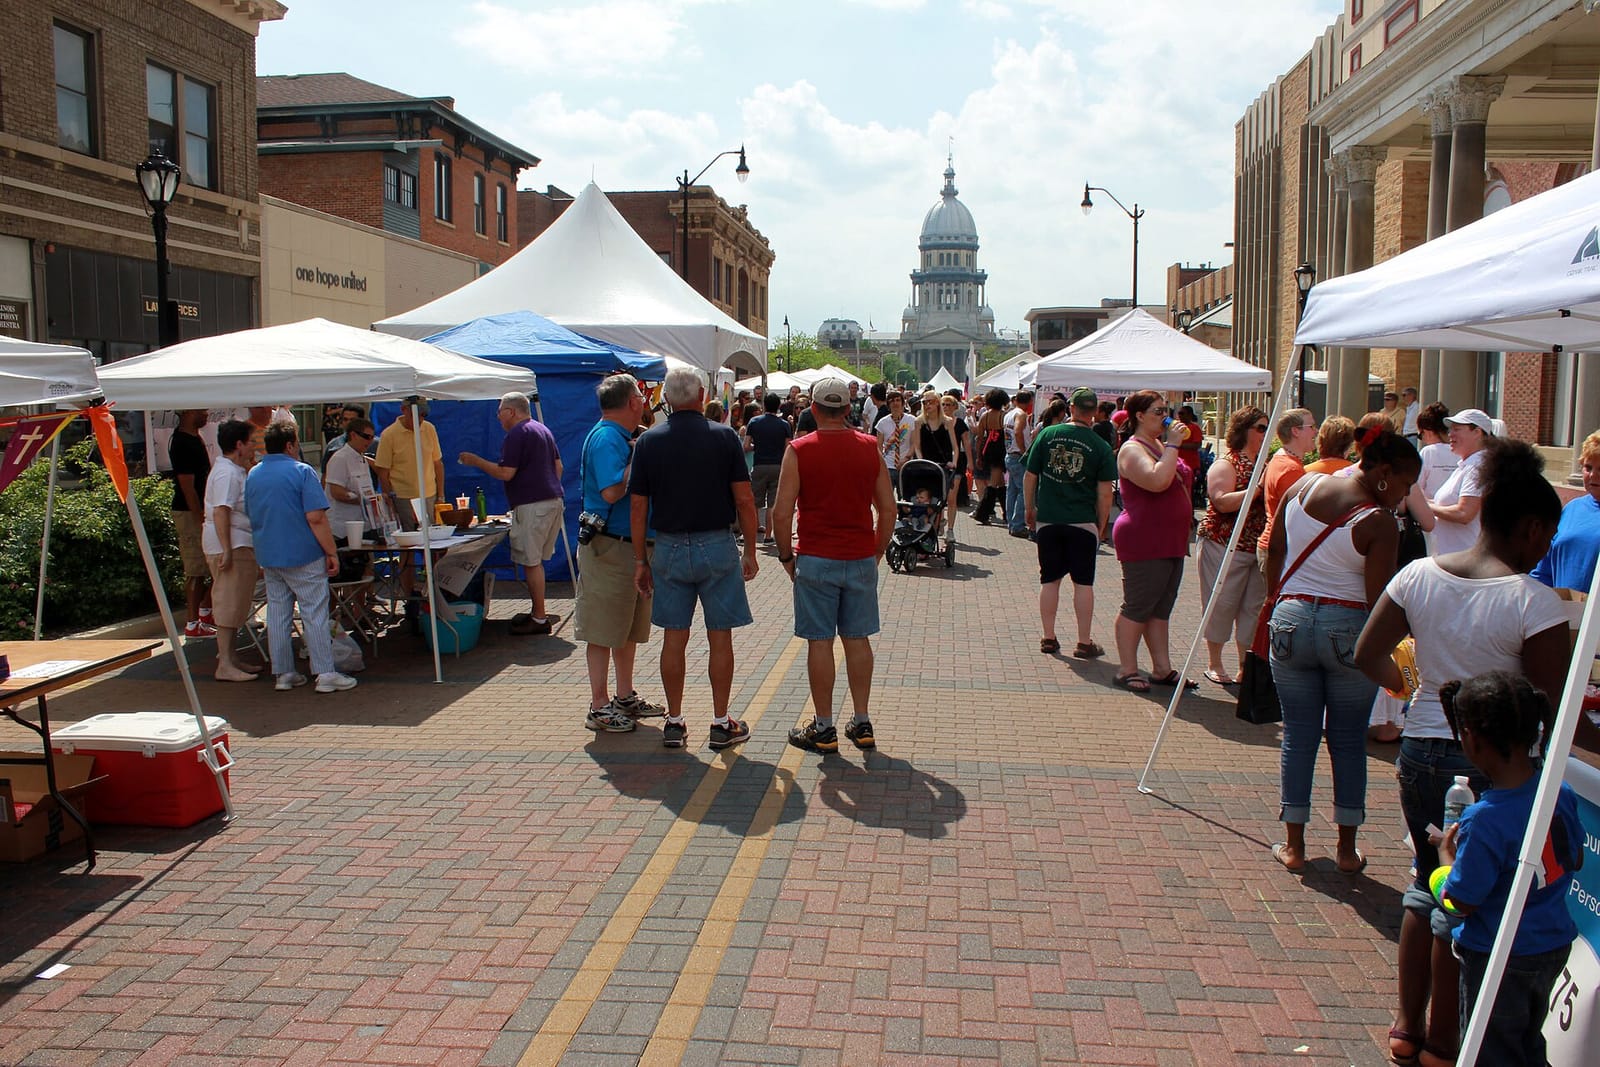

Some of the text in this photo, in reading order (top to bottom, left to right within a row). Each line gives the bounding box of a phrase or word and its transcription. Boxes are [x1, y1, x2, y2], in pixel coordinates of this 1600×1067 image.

[295, 266, 367, 292] one hope united
